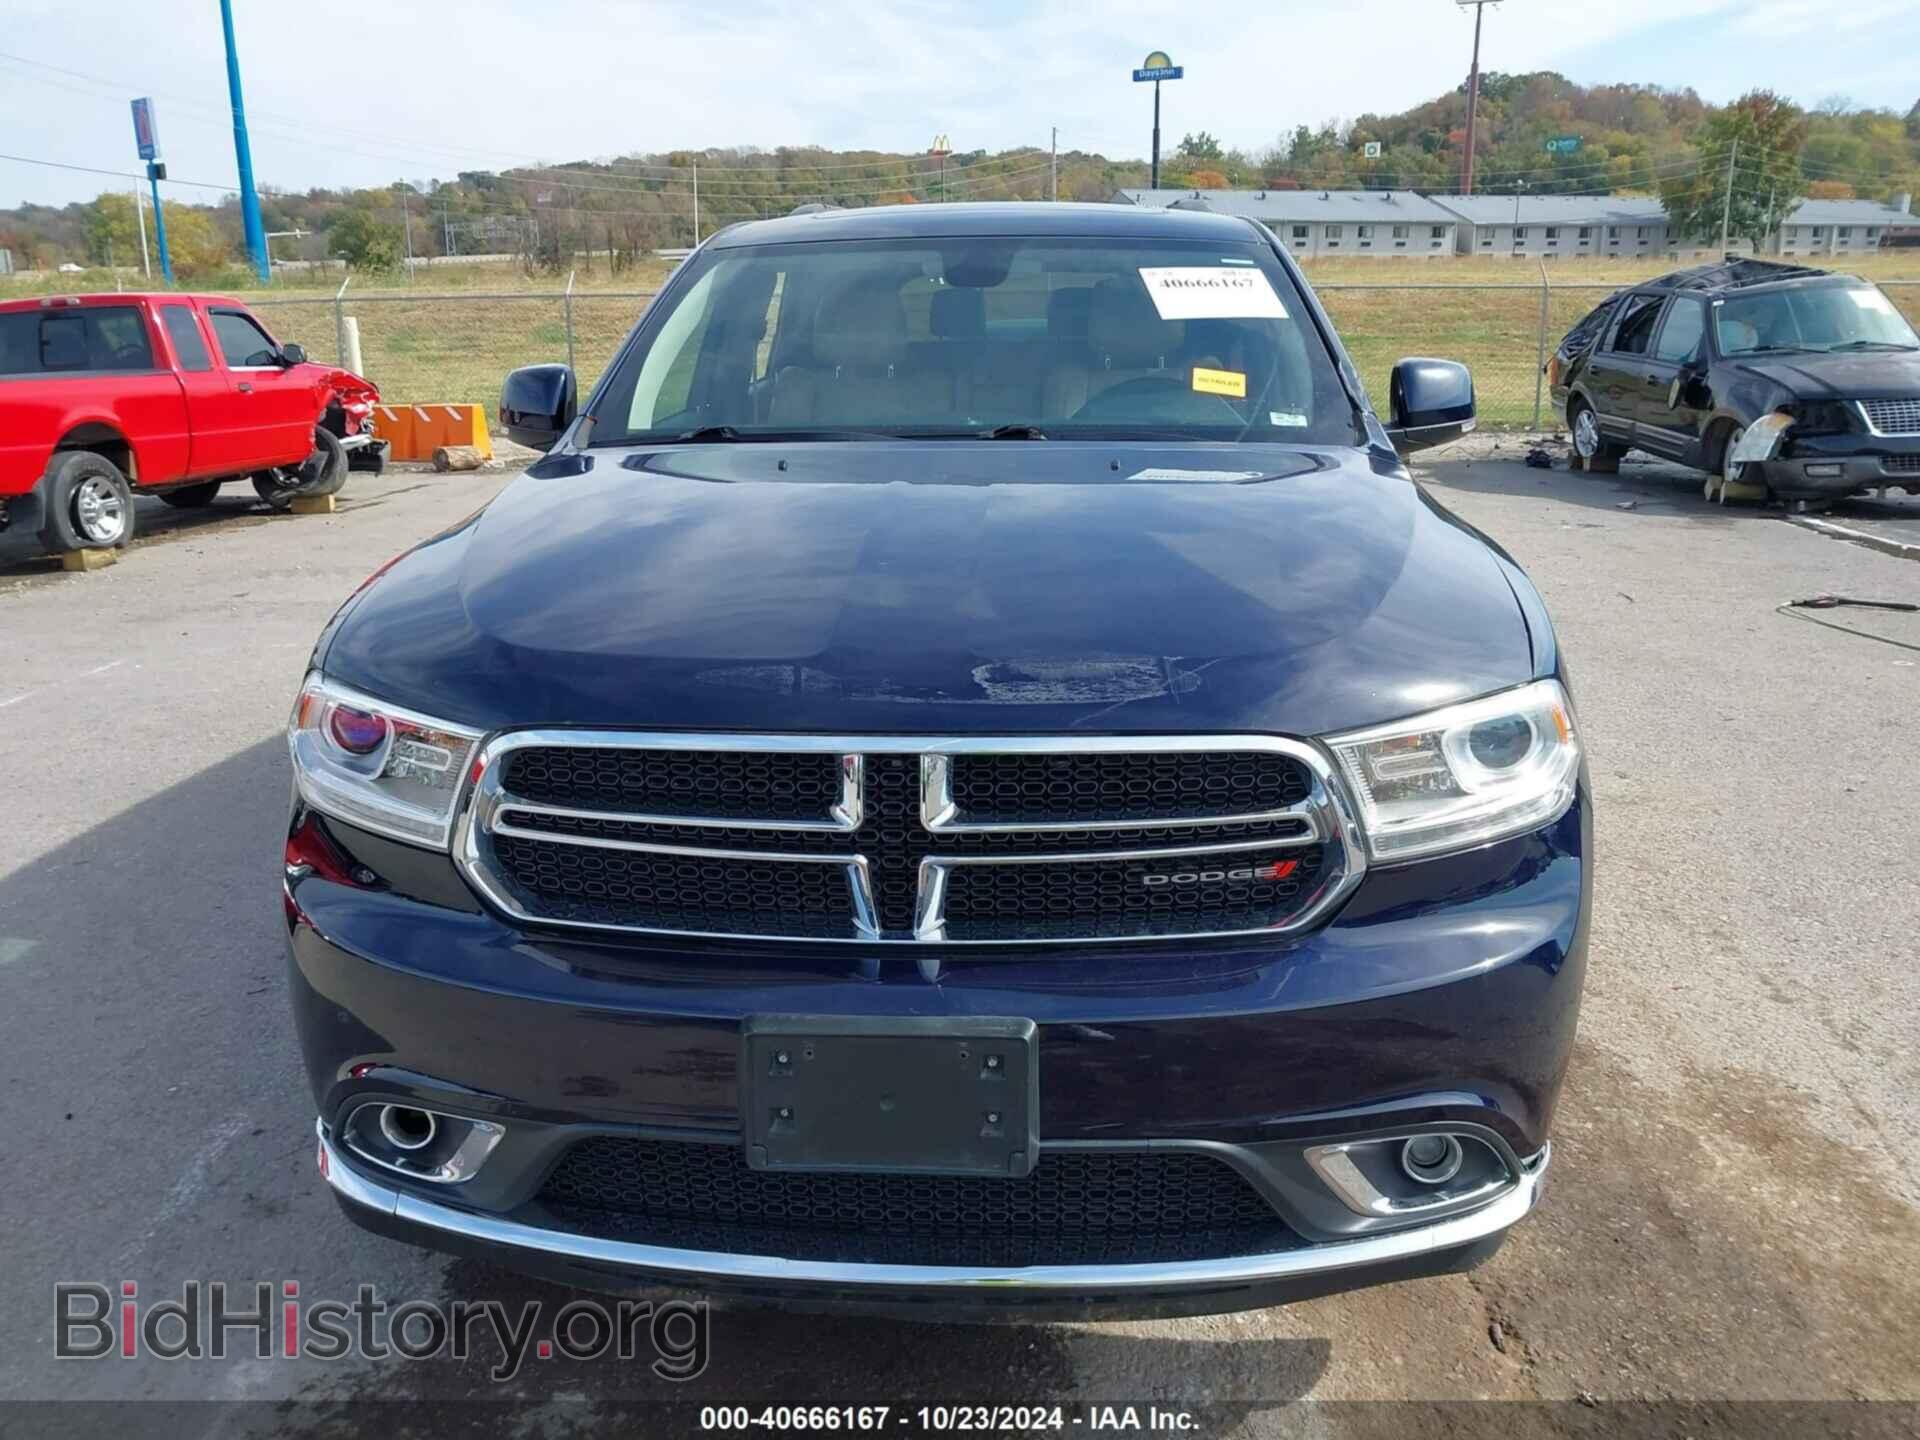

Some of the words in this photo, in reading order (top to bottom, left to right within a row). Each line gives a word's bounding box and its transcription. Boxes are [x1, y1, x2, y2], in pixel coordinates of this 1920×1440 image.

[1139, 69, 1159, 78] Days
[1159, 278, 1254, 290] 40666167
[1143, 865, 1278, 886] DODGE
